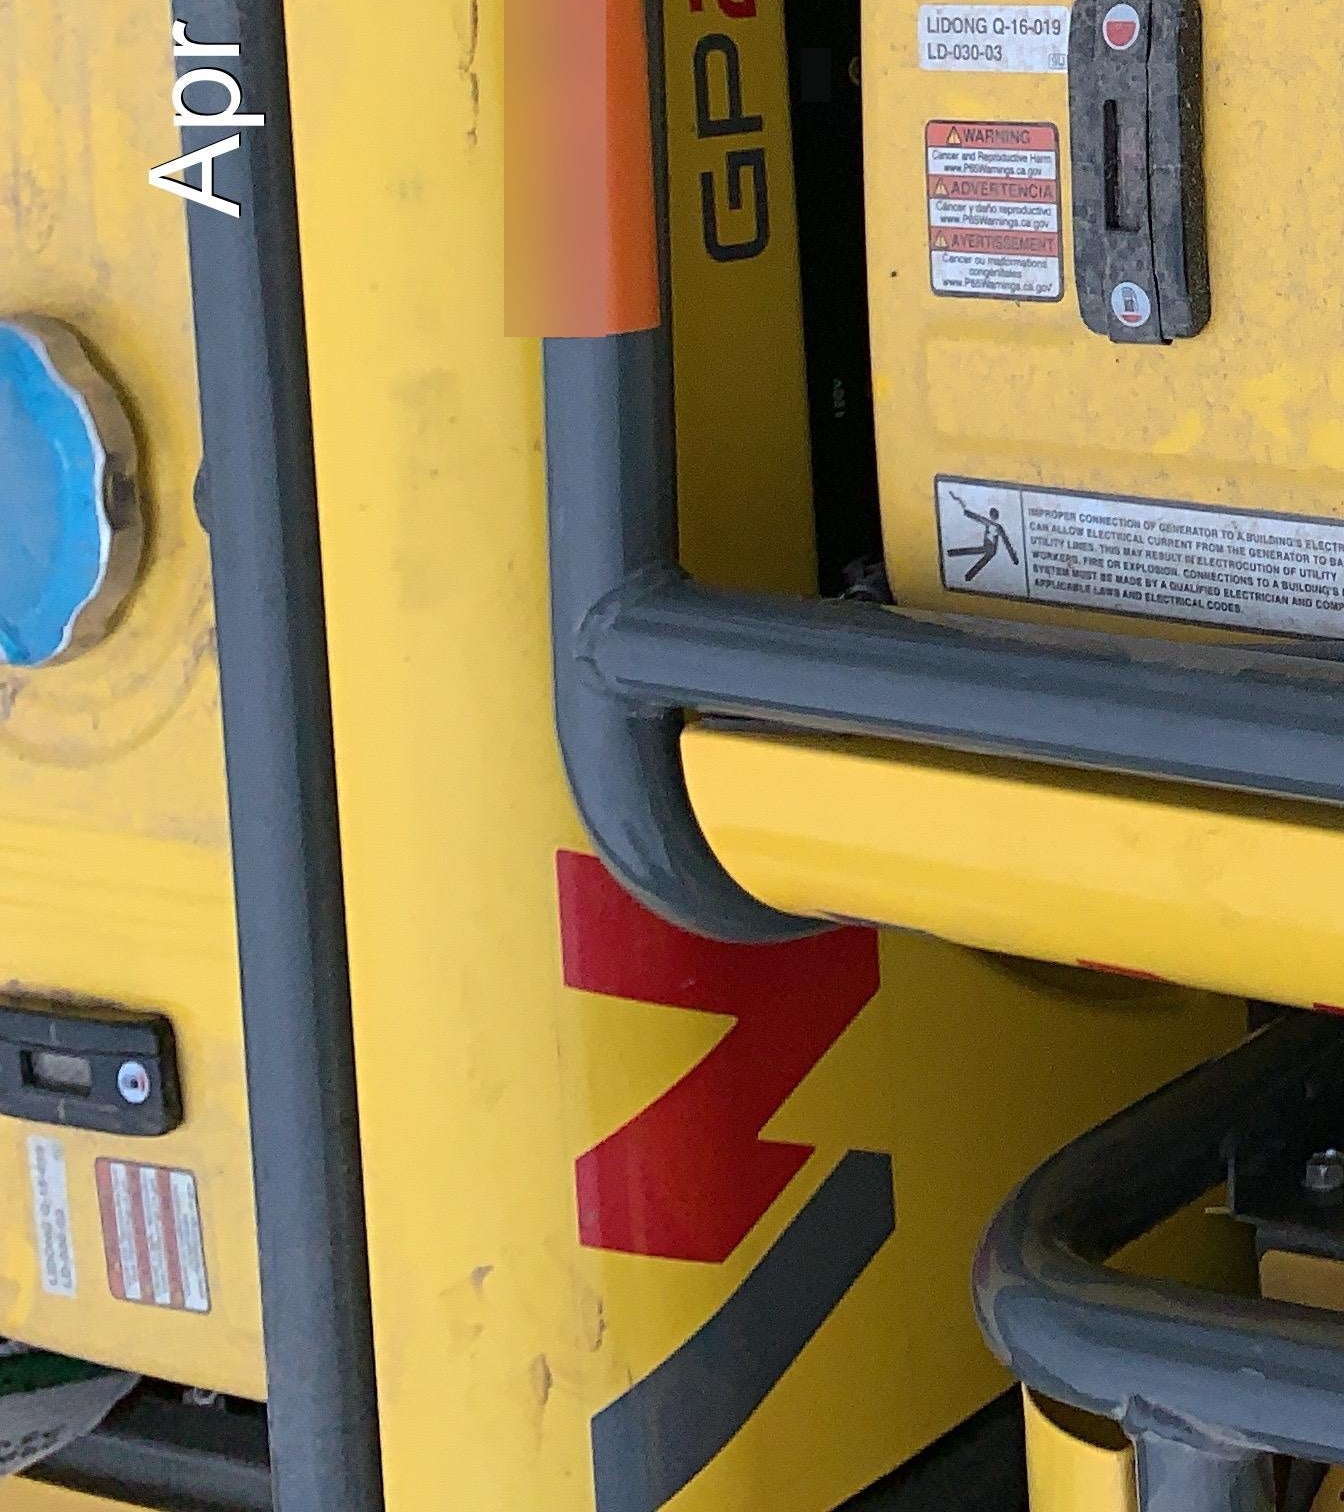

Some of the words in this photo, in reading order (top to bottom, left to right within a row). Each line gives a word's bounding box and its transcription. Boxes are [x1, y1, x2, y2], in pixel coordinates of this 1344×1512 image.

[927, 18, 988, 35] LIDONG
[992, 18, 1062, 37] Q-16-019
[927, 45, 1002, 62] LD-030-03
[963, 129, 1030, 144] WARNING
[951, 181, 1053, 198] ADVERTENCIA
[1148, 534, 1192, 548] CURRENT
[1196, 540, 1224, 552] FROM
[1249, 546, 1309, 562] GENERATOR
